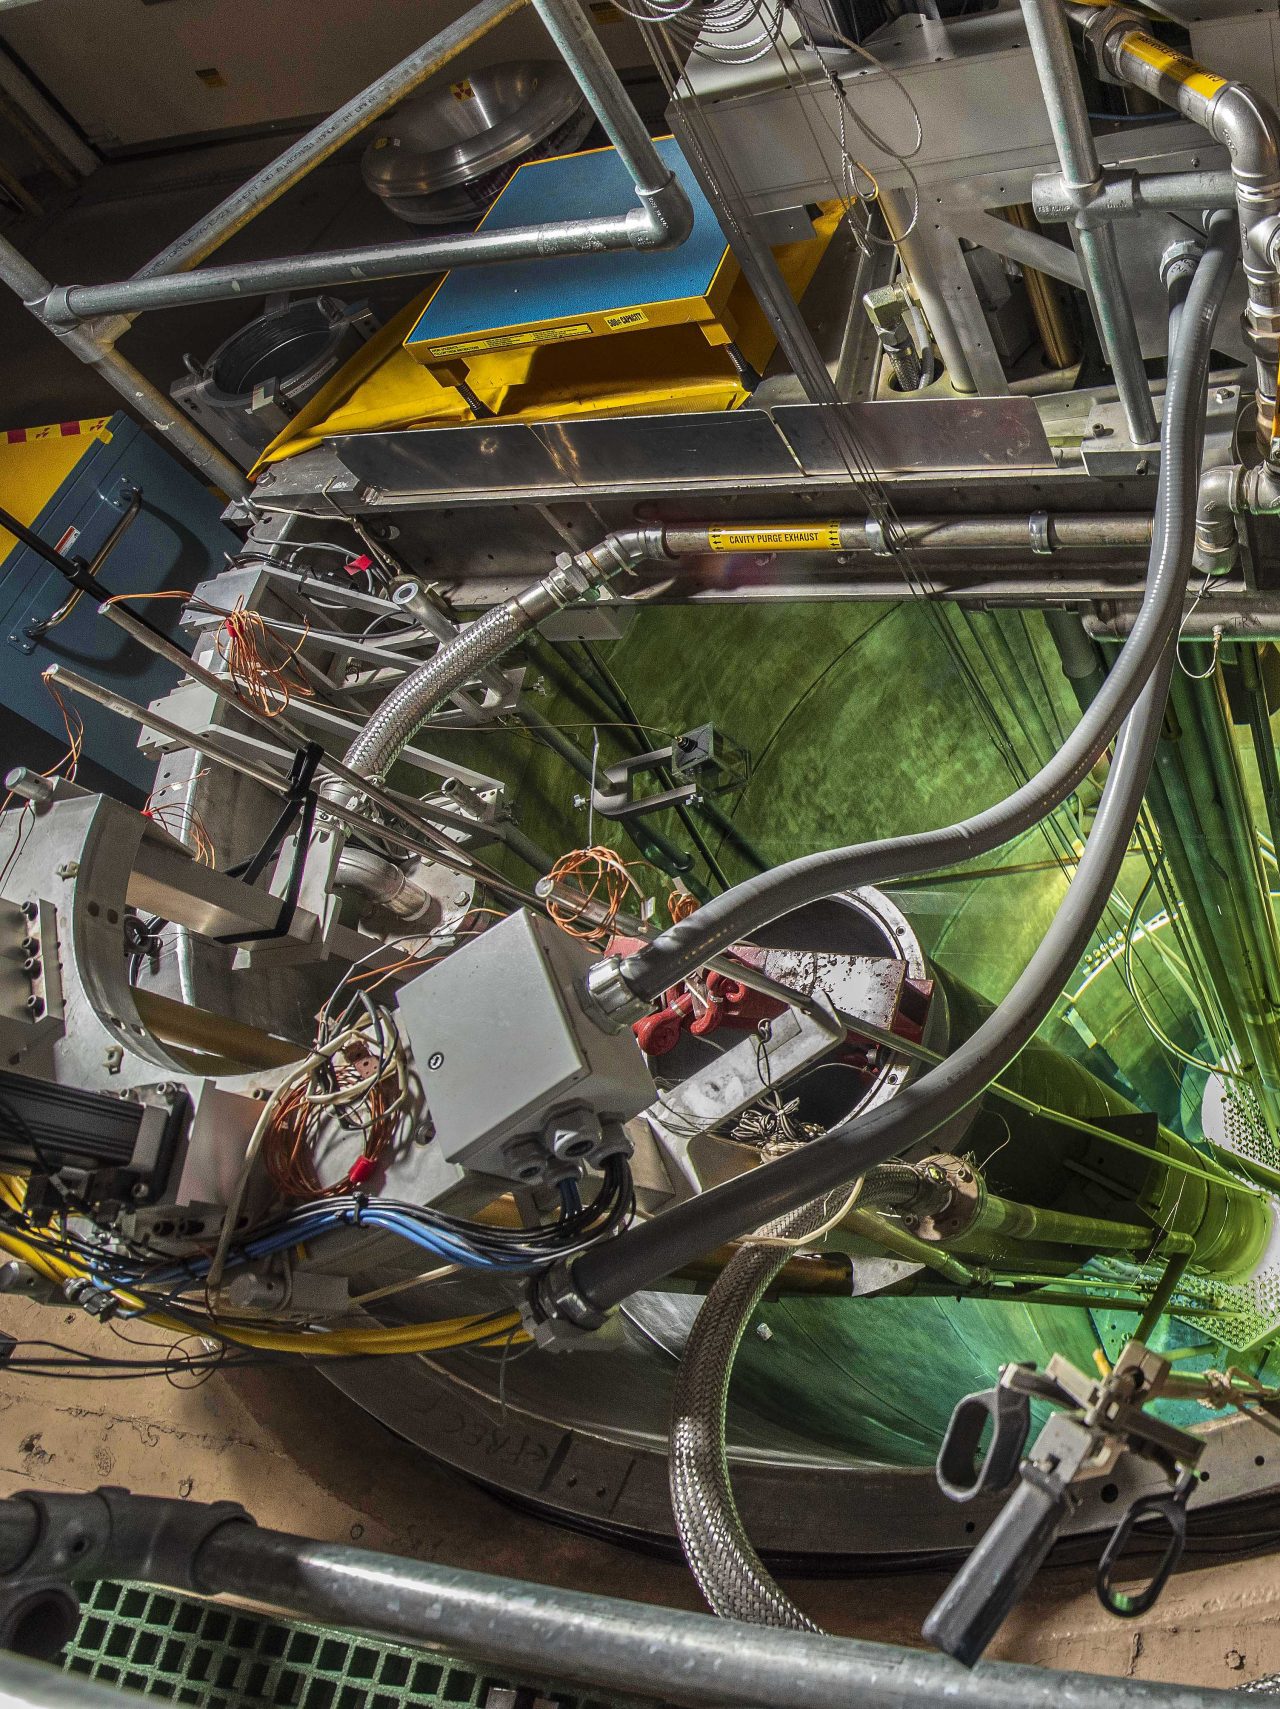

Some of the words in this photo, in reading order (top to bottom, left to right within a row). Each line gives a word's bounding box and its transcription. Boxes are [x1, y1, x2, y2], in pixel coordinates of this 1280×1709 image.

[619, 312, 643, 324] CAPACITY
[729, 535, 755, 544] CAVITY
[757, 534, 782, 543] PURGE
[784, 532, 819, 542] EXHAUST
